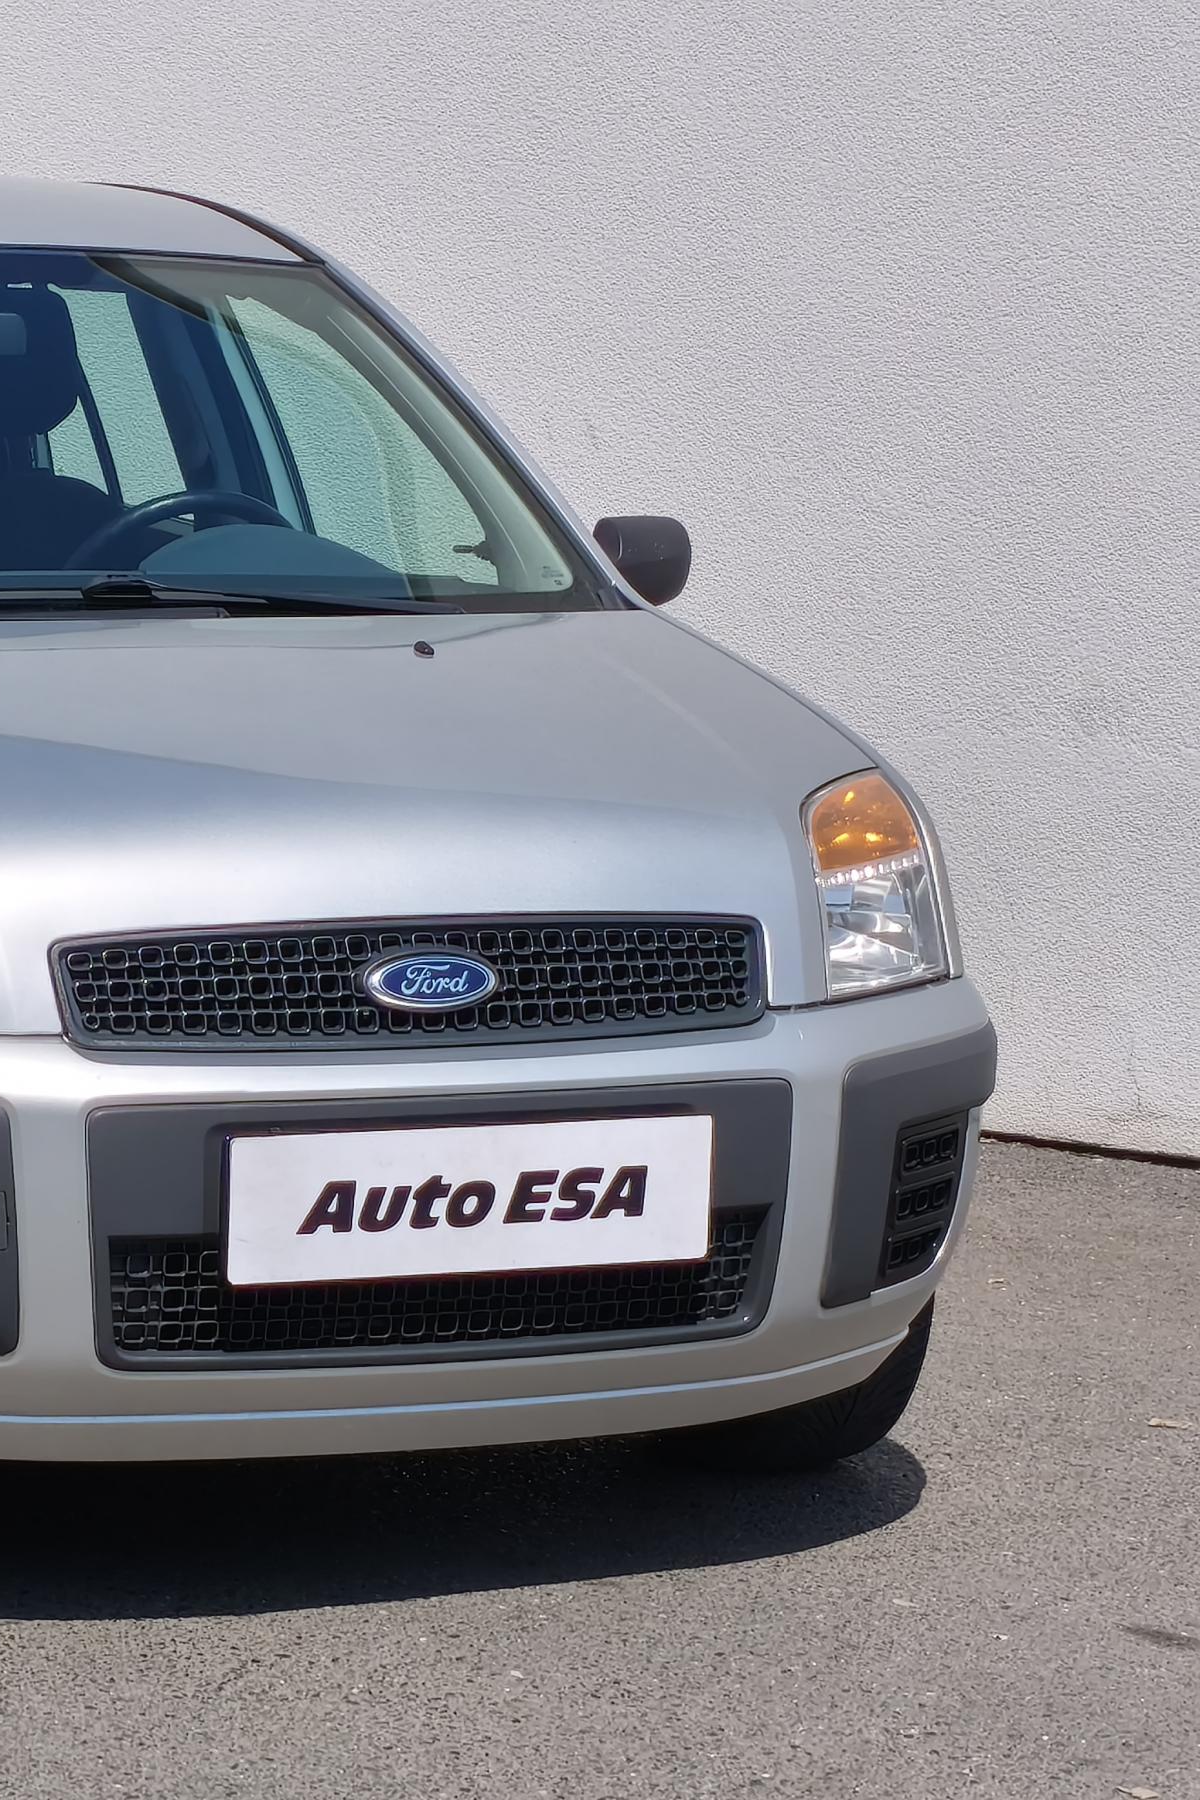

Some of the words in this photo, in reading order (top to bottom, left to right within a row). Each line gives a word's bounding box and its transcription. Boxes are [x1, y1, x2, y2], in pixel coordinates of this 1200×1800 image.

[401, 964, 469, 995] Ford
[295, 1175, 496, 1235] Auto
[502, 1165, 648, 1225] ESA
